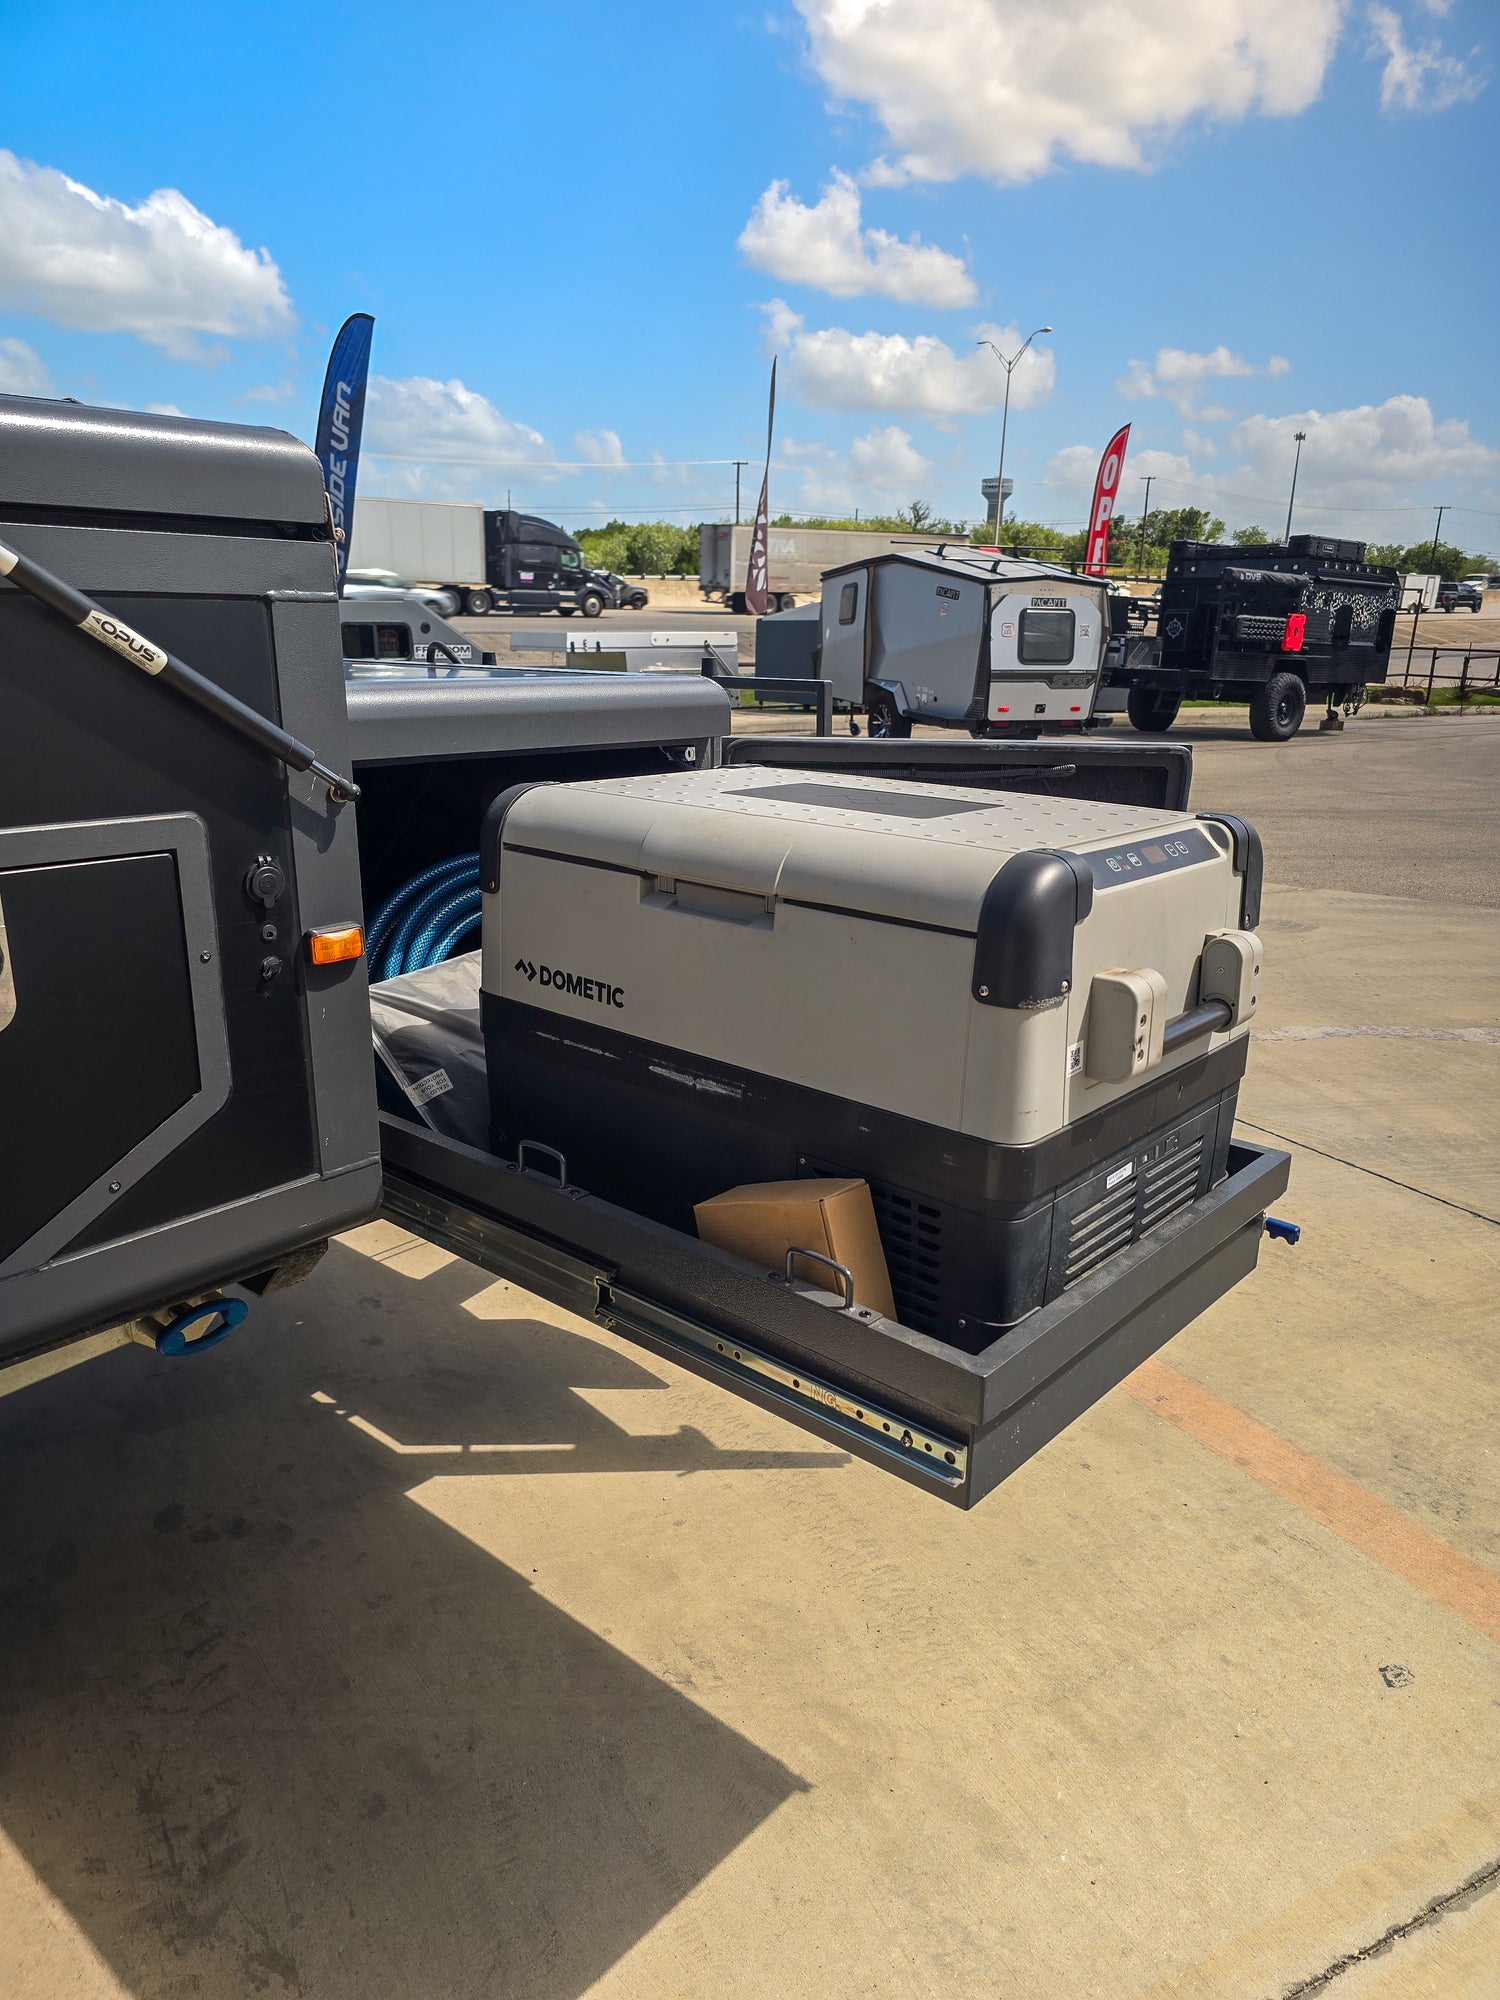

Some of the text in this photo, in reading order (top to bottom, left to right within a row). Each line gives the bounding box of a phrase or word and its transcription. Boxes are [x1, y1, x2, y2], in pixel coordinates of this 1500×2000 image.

[330, 381, 351, 452] VAN
[1091, 454, 1118, 572] OPE
[101, 620, 155, 662] OPUS
[415, 646, 470, 654] FROM
[539, 965, 625, 1009] DOMETIC
